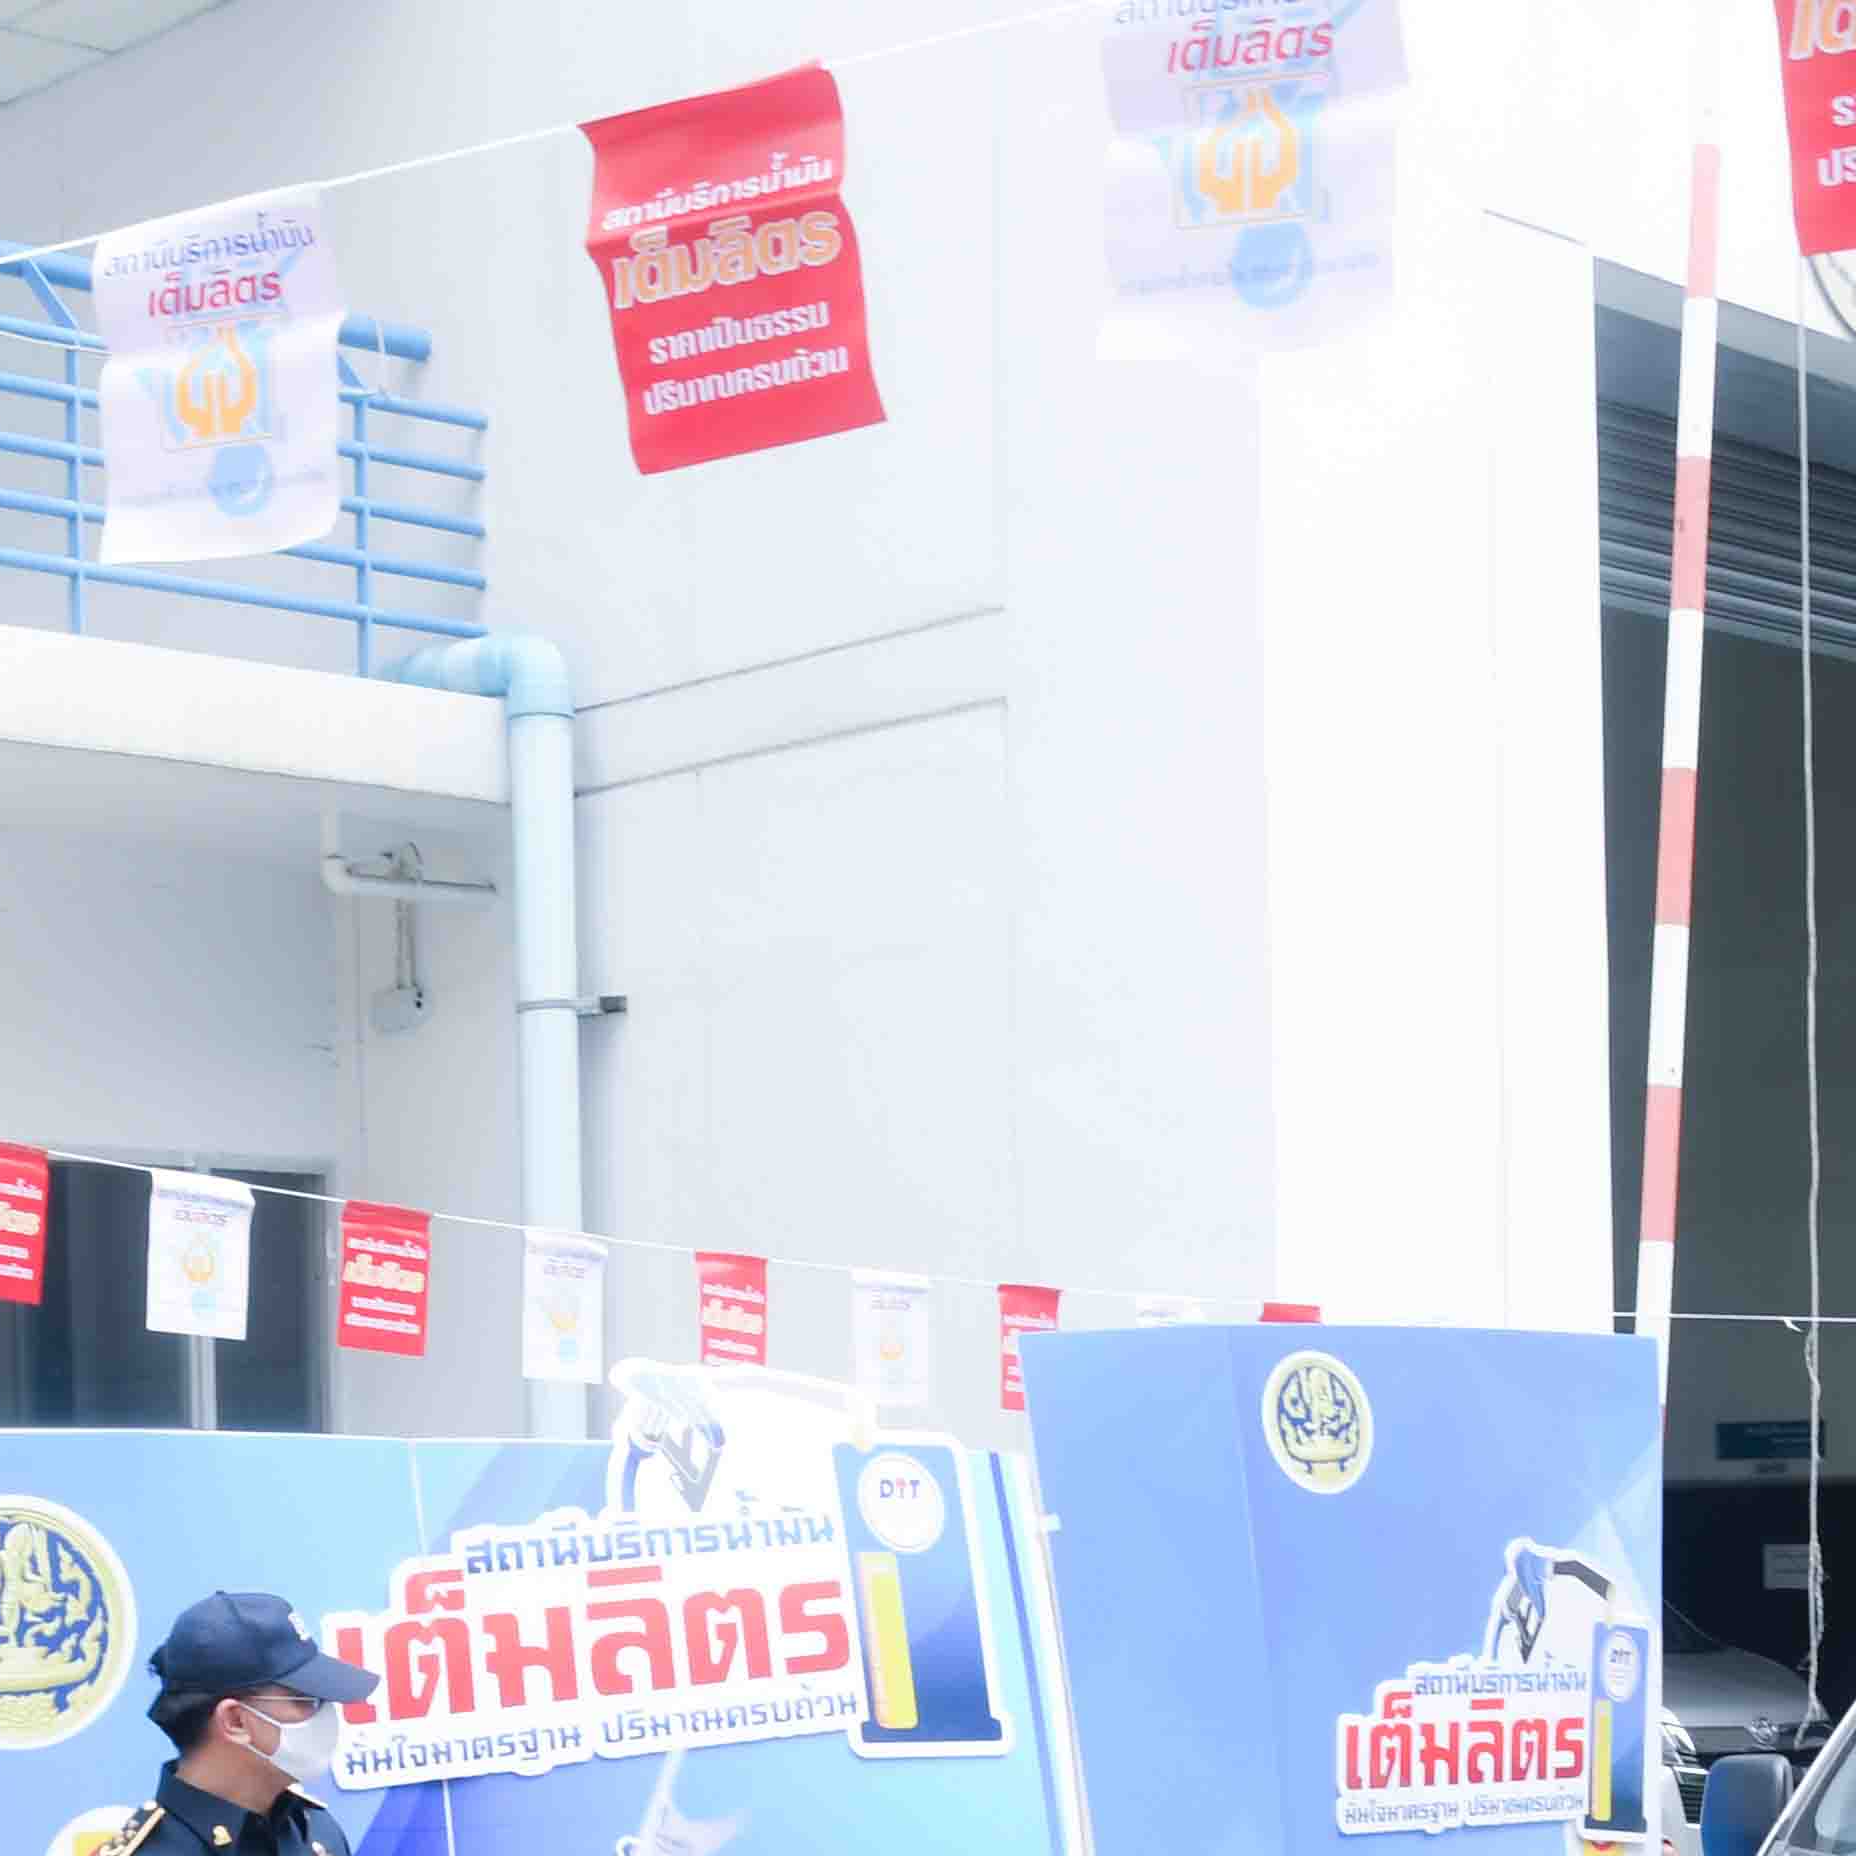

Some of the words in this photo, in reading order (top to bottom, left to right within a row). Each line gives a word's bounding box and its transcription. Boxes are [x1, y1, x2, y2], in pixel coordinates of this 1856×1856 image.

[1166, 18, 1336, 75] เต็มลิตร
[601, 150, 834, 234] สถานีบริการน้ำมัน
[104, 212, 316, 278] สถานีบริการน้ำมัน
[612, 208, 844, 310] เต็มลิตร
[147, 265, 282, 318] เต็มลิตร
[648, 302, 830, 366] ราคาเป็นธรรม
[642, 345, 850, 418] ปริมาณครบถ้วน
[878, 1475, 921, 1502] DIT
[464, 1489, 834, 1575] สถานีบริการน้ำมัน
[336, 1565, 851, 1725] เต็มลิตร
[1413, 1654, 1588, 1695] สถานีบริการน้ำมัน
[344, 1722, 582, 1777] มั่นใจมาตรฐาน
[601, 1683, 858, 1745] ปริมาณครบถ้วน
[1345, 1691, 1585, 1790] เต็มลิตร
